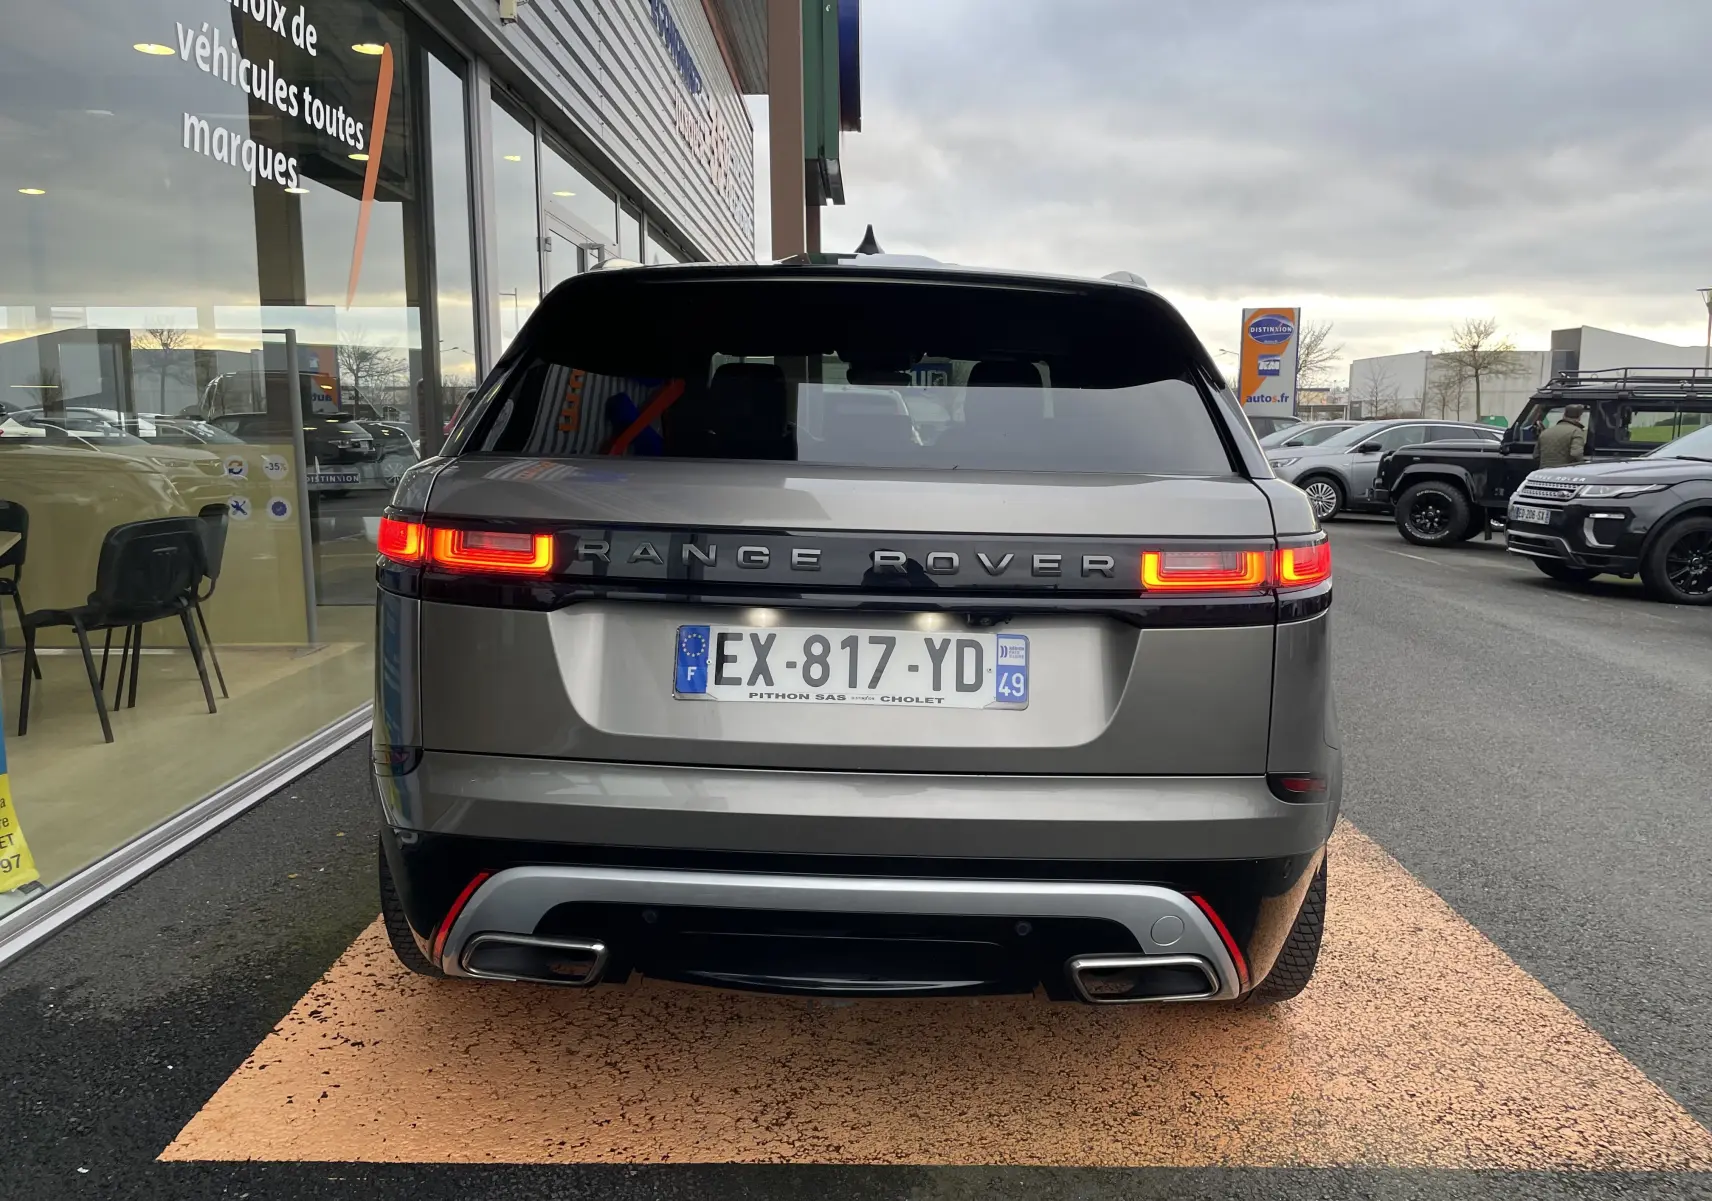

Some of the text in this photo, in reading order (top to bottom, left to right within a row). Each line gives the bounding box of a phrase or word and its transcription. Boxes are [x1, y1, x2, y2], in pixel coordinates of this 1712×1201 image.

[227, 0, 318, 57] oix de
[176, 21, 364, 150] véhicules toutes
[183, 112, 298, 189] marques
[1246, 392, 1290, 403] autos.fr
[577, 541, 1116, 578] RANGE ROVER
[686, 666, 698, 681] F
[714, 632, 984, 692] EX-817-YD
[748, 692, 809, 700] PITHON
[880, 695, 945, 704] CHOLET
[998, 672, 1025, 697] 49
